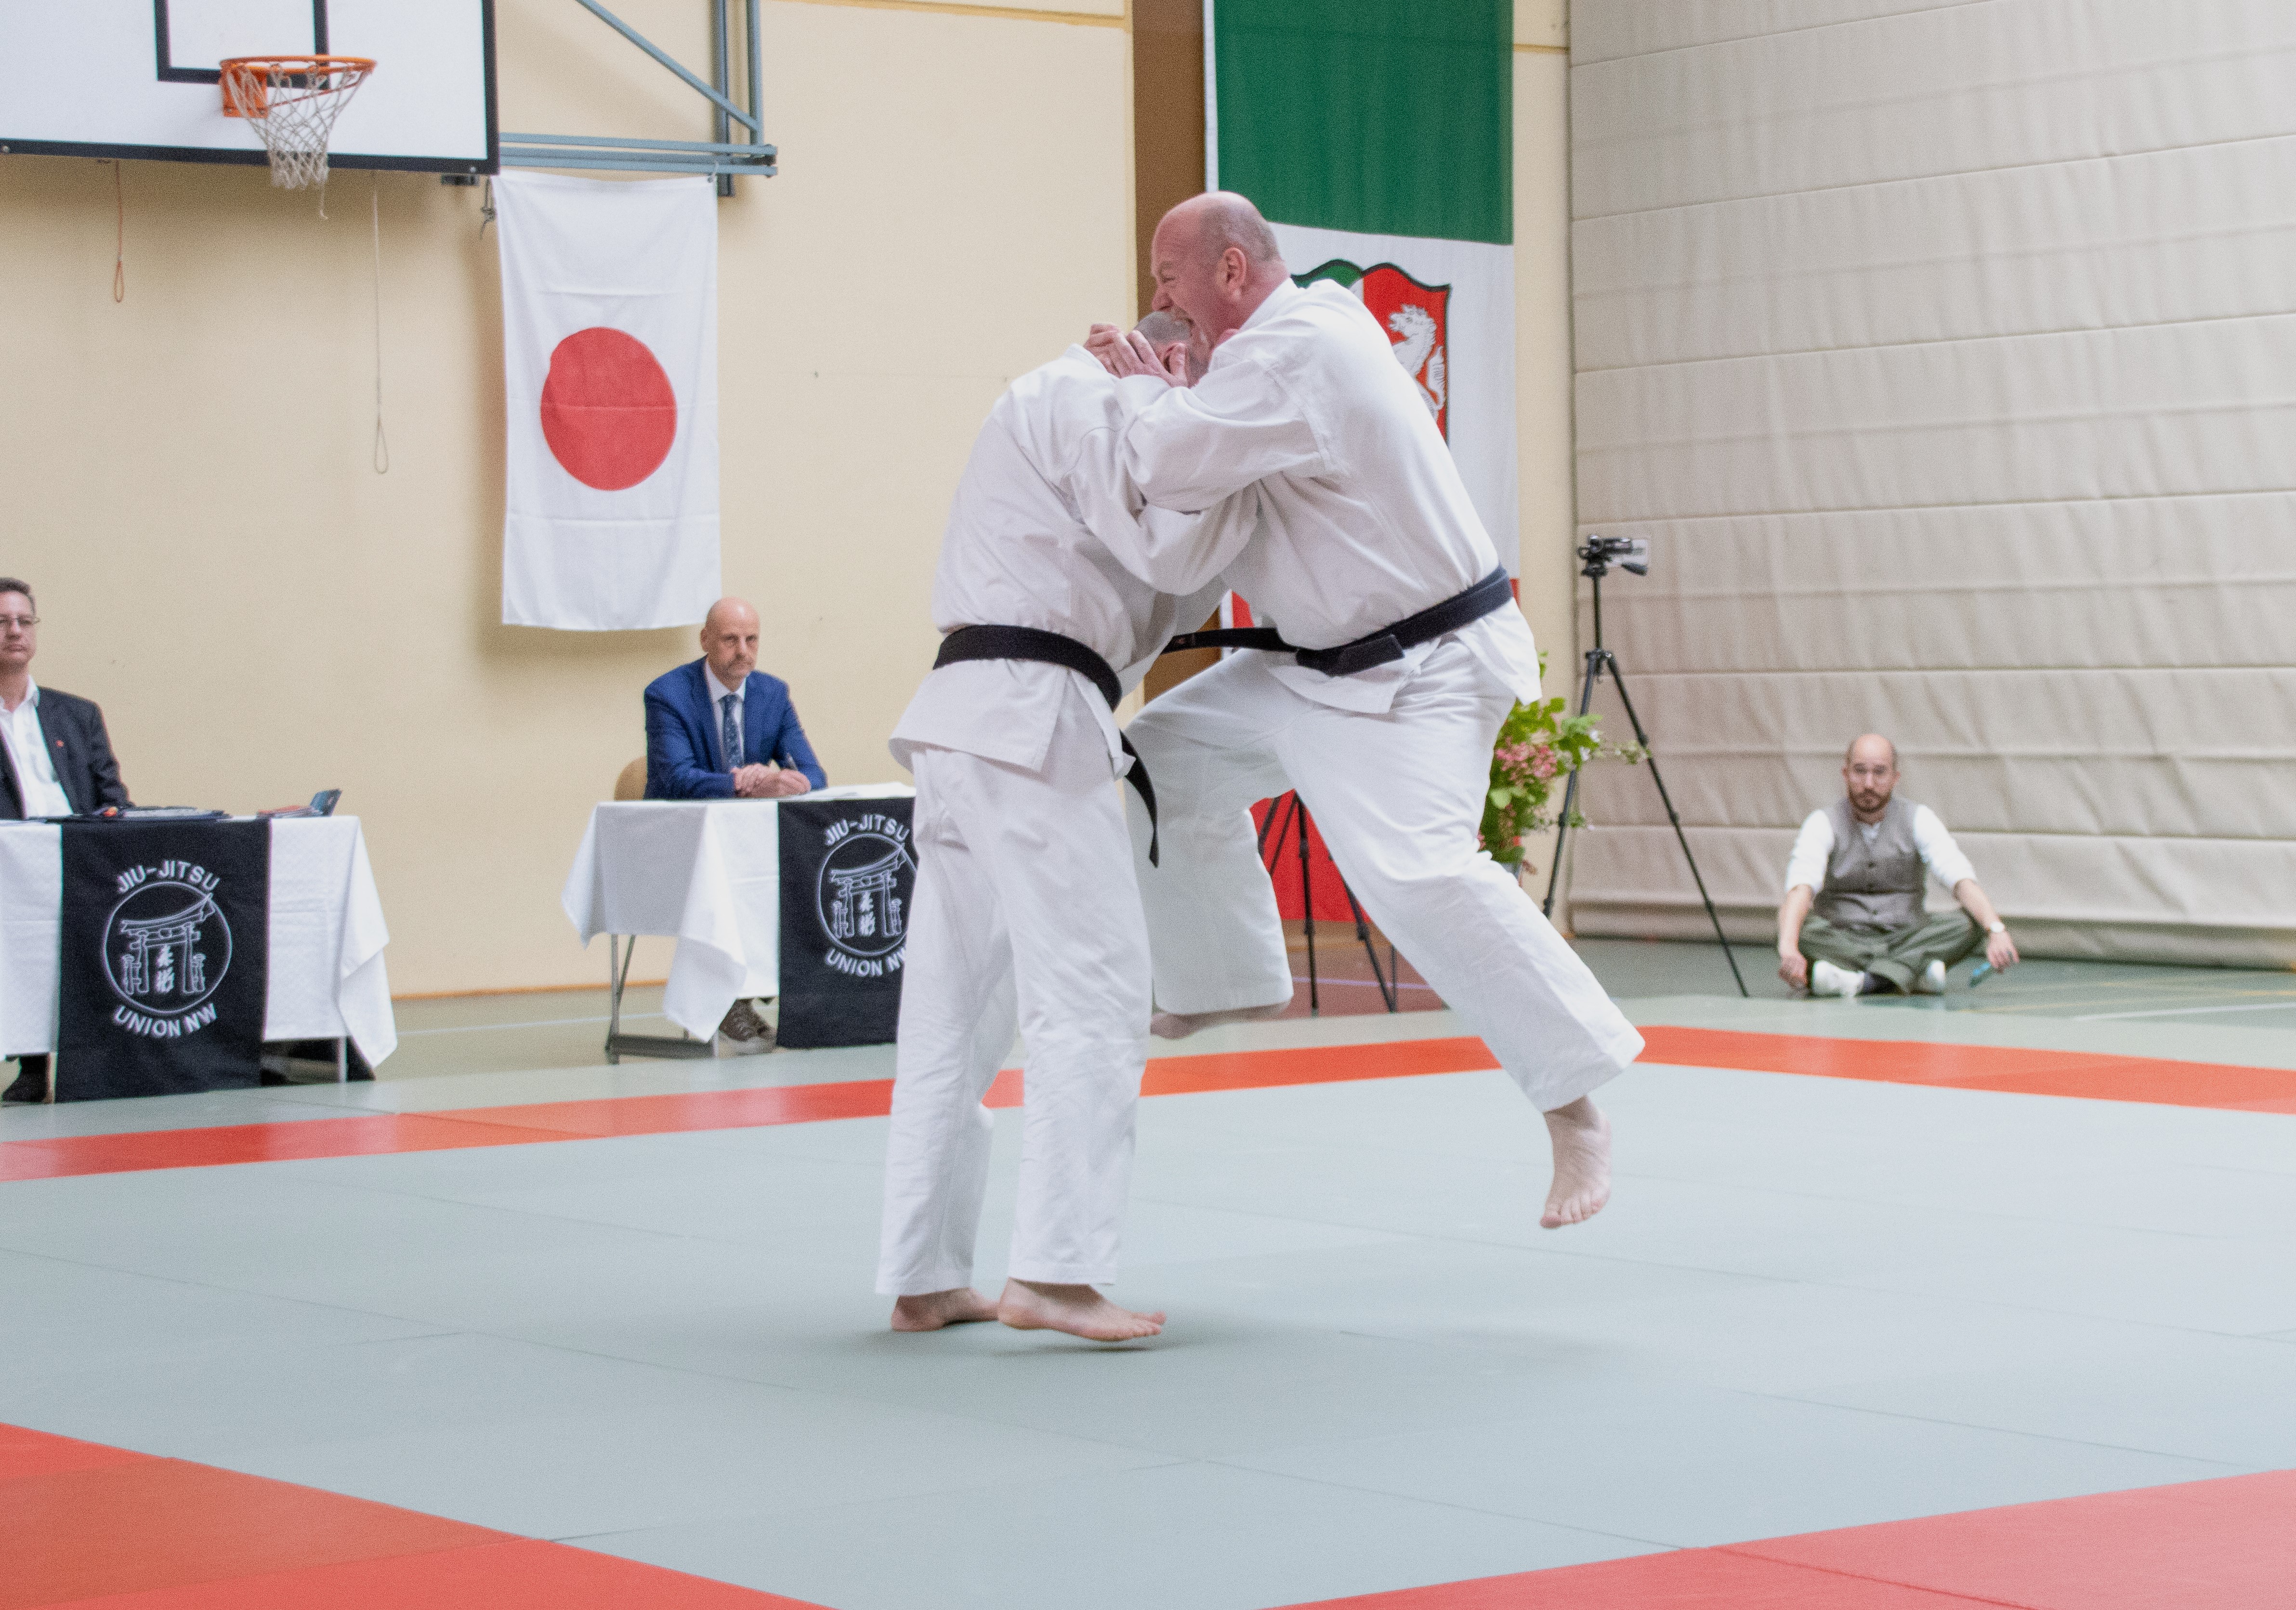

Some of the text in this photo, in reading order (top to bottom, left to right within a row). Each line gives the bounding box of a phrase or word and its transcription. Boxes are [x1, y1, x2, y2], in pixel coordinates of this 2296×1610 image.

[826, 814, 910, 845] JIU-JITSU
[117, 860, 220, 893] JIU-JITSU
[826, 948, 883, 977] UNION
[114, 1003, 217, 1037] UNION NW
